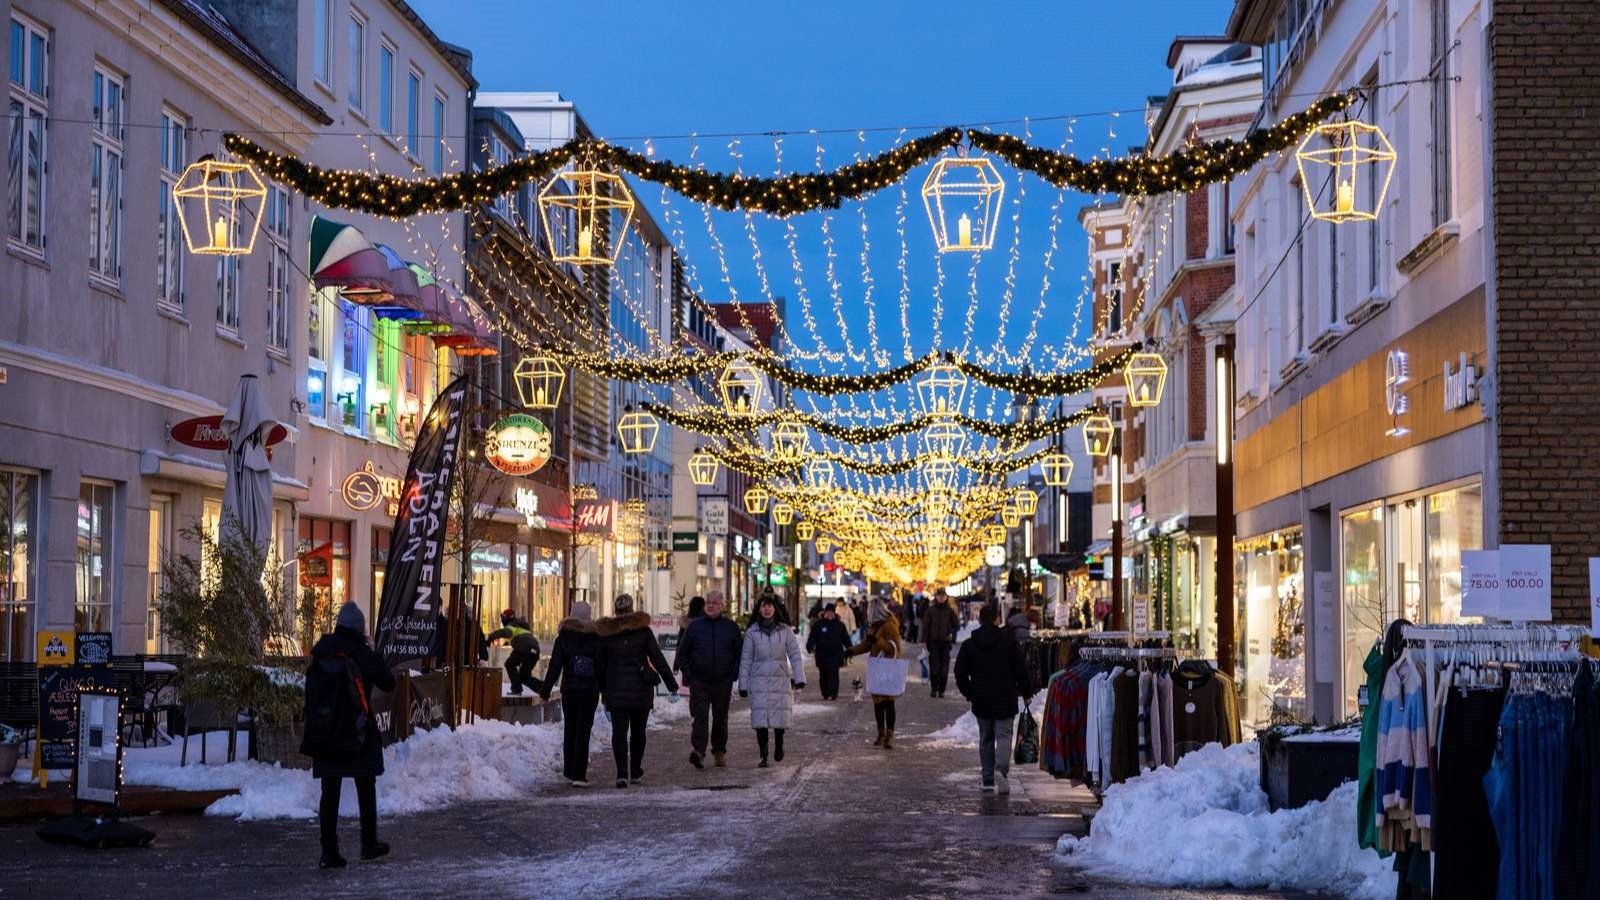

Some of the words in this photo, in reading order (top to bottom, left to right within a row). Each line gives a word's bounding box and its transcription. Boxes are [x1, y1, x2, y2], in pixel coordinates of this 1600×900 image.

[578, 505, 610, 527] H&M
[1470, 580, 1499, 589] 75.00
[1506, 578, 1544, 589] 100.00
